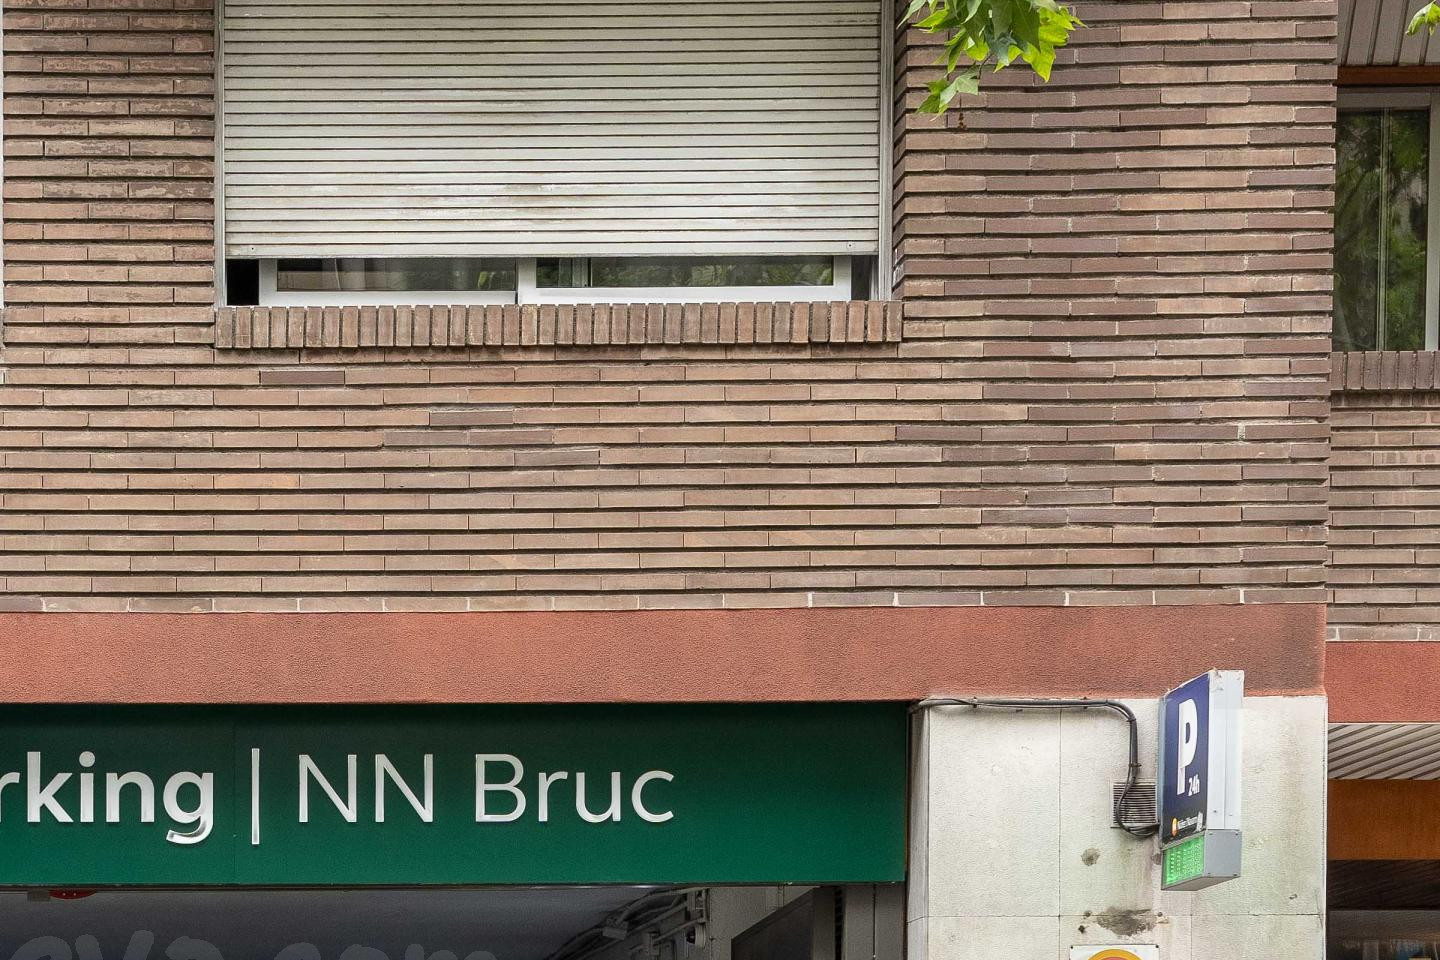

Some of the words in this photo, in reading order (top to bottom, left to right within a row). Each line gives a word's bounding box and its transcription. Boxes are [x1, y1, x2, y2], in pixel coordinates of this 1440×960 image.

[1176, 698, 1198, 795] P
[298, 754, 434, 823] NN
[474, 753, 675, 824] Bruc
[1188, 773, 1201, 796] 24h
